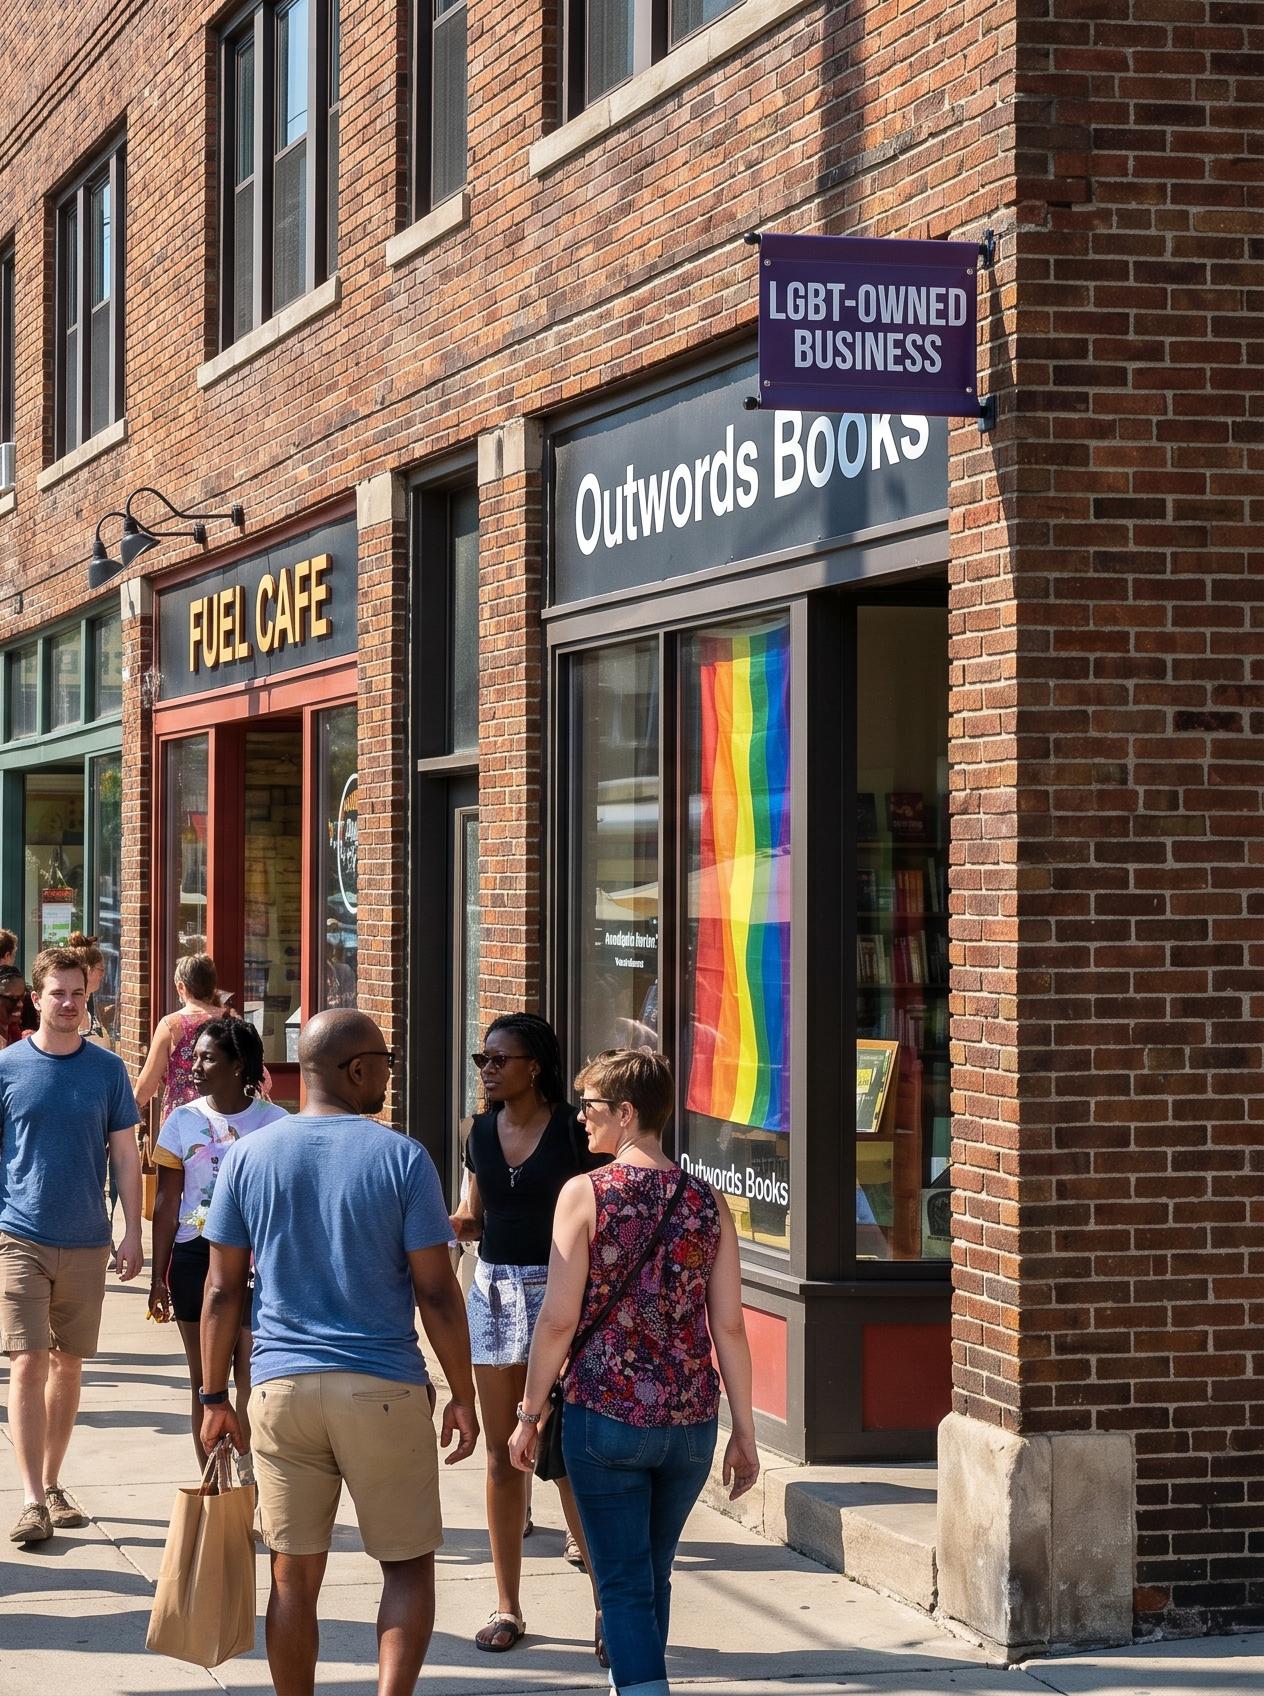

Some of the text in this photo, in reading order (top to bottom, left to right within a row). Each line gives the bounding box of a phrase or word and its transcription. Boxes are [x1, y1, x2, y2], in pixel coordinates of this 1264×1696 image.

[769, 280, 968, 327] LGBT-OWNED
[794, 329, 943, 374] BUSINESS
[575, 423, 759, 556] Outwords
[189, 553, 333, 673] FUEL CAFE
[745, 1167, 790, 1206] Books
